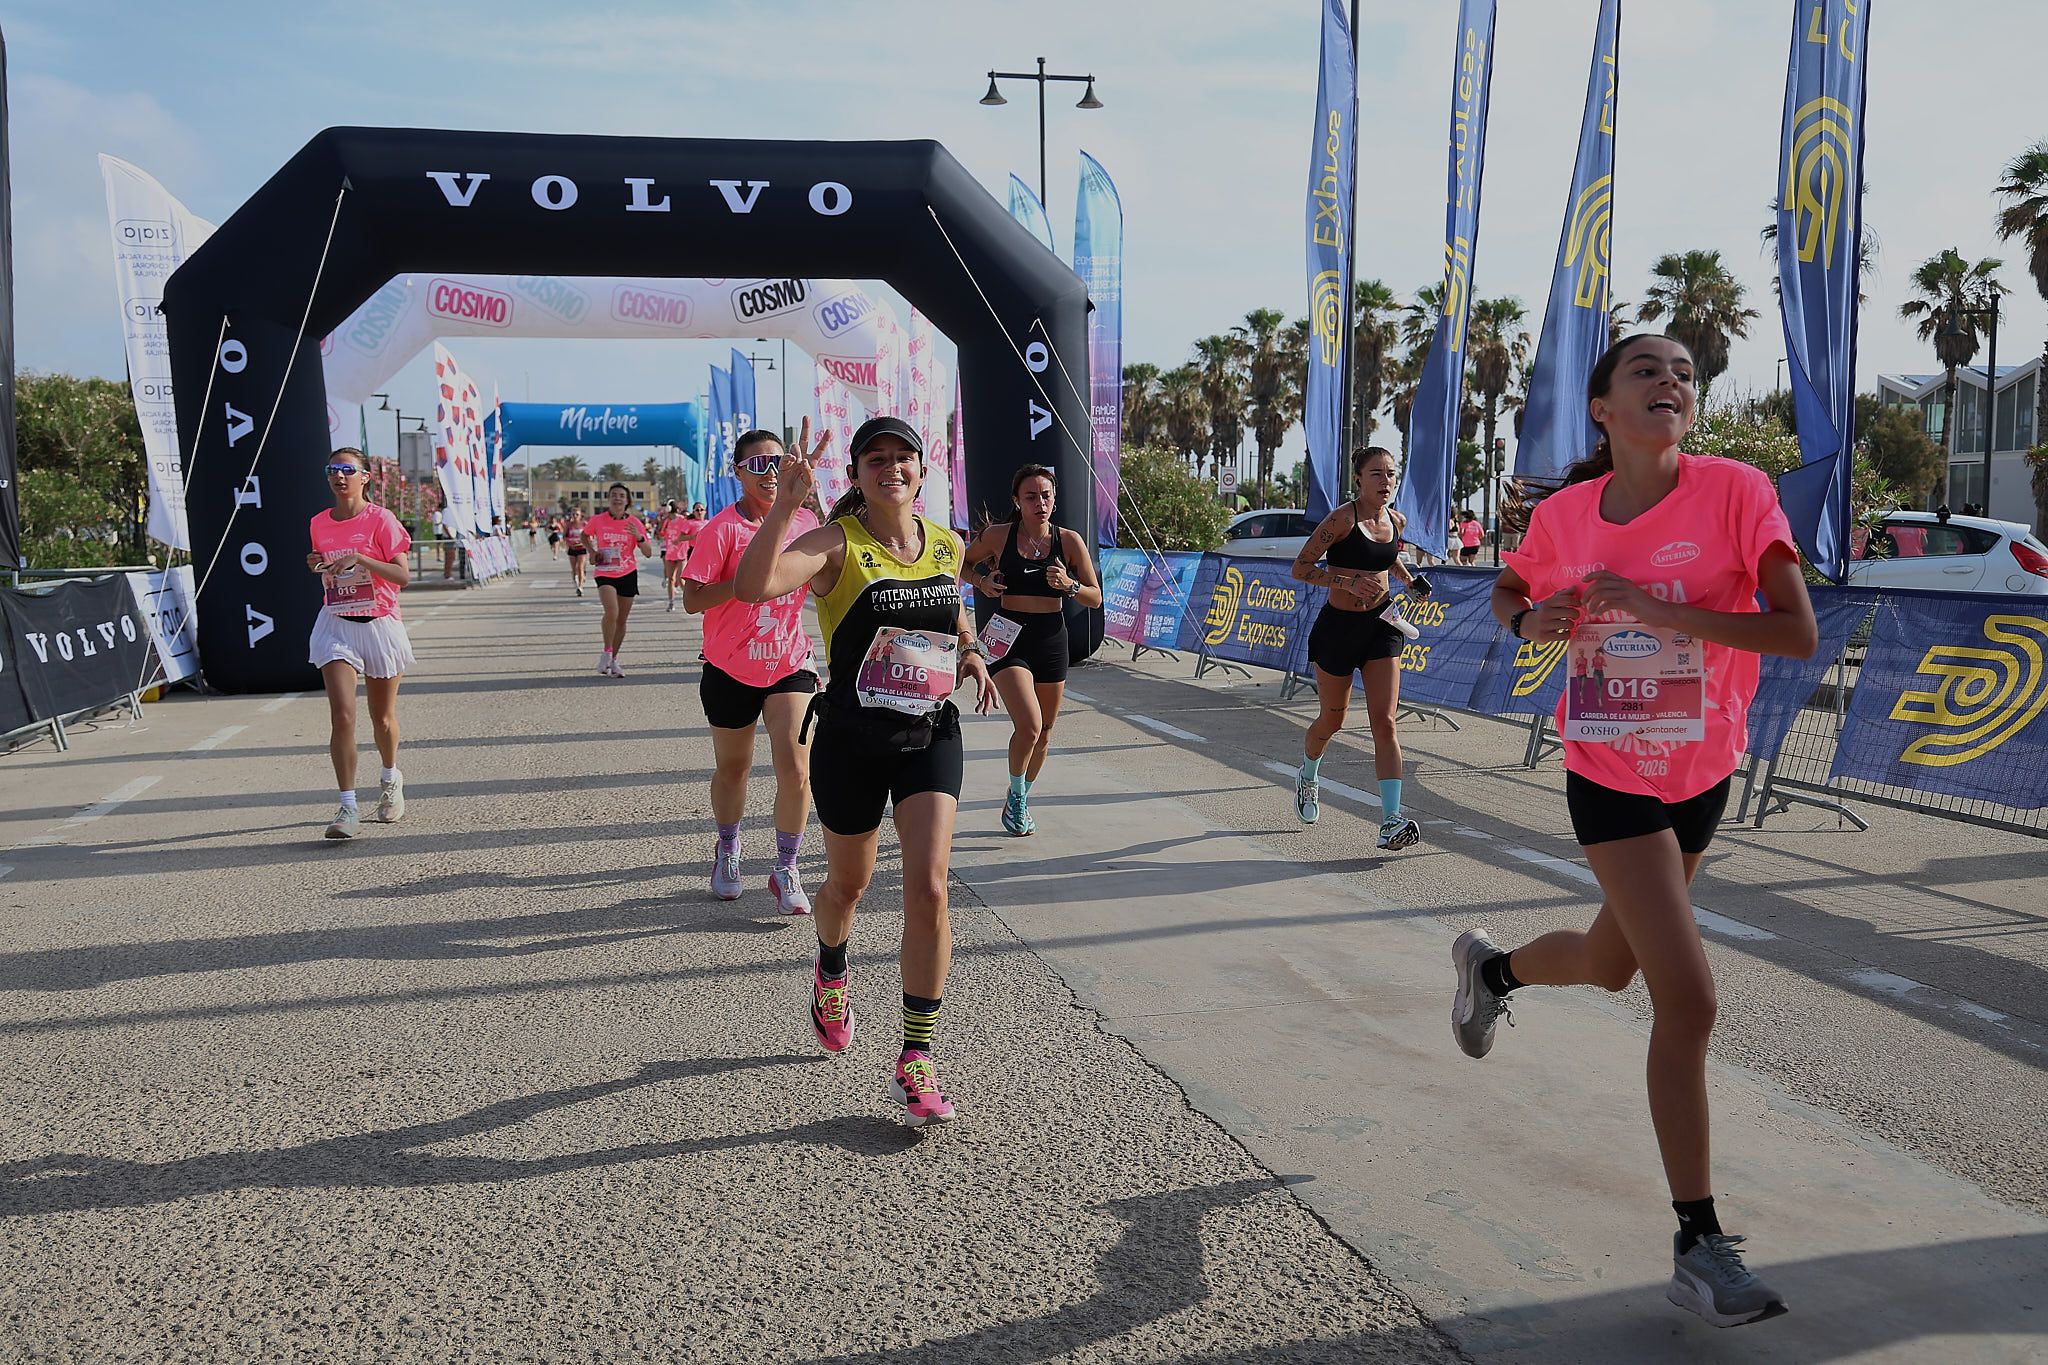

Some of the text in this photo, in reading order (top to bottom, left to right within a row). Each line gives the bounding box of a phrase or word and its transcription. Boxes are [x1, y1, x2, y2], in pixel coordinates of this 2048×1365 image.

[426, 171, 853, 216] VOLVO
[434, 284, 507, 323] COSMO
[738, 278, 805, 318] COSMO
[618, 290, 687, 325] COSMO
[219, 338, 275, 649] VOLVO
[1654, 548, 1697, 565] ASTURIANA
[337, 585, 357, 596] 016
[871, 588, 920, 604] PATERNA
[1247, 579, 1297, 612] Correos
[25, 614, 138, 663] VOLVO
[984, 635, 997, 647] 016
[1236, 614, 1288, 652] Express
[1606, 640, 1657, 652] ASTURIANA
[891, 663, 928, 685] 016
[1607, 678, 1659, 699] 016
[865, 696, 897, 707] OYSHO
[1621, 702, 1644, 711] 2981
[1580, 711, 1608, 720] CARRERA
[1618, 713, 1627, 721] LA
[1580, 725, 1620, 736] OYSHO
[1645, 726, 1688, 734] Santander
[1636, 759, 1668, 777] 2026
